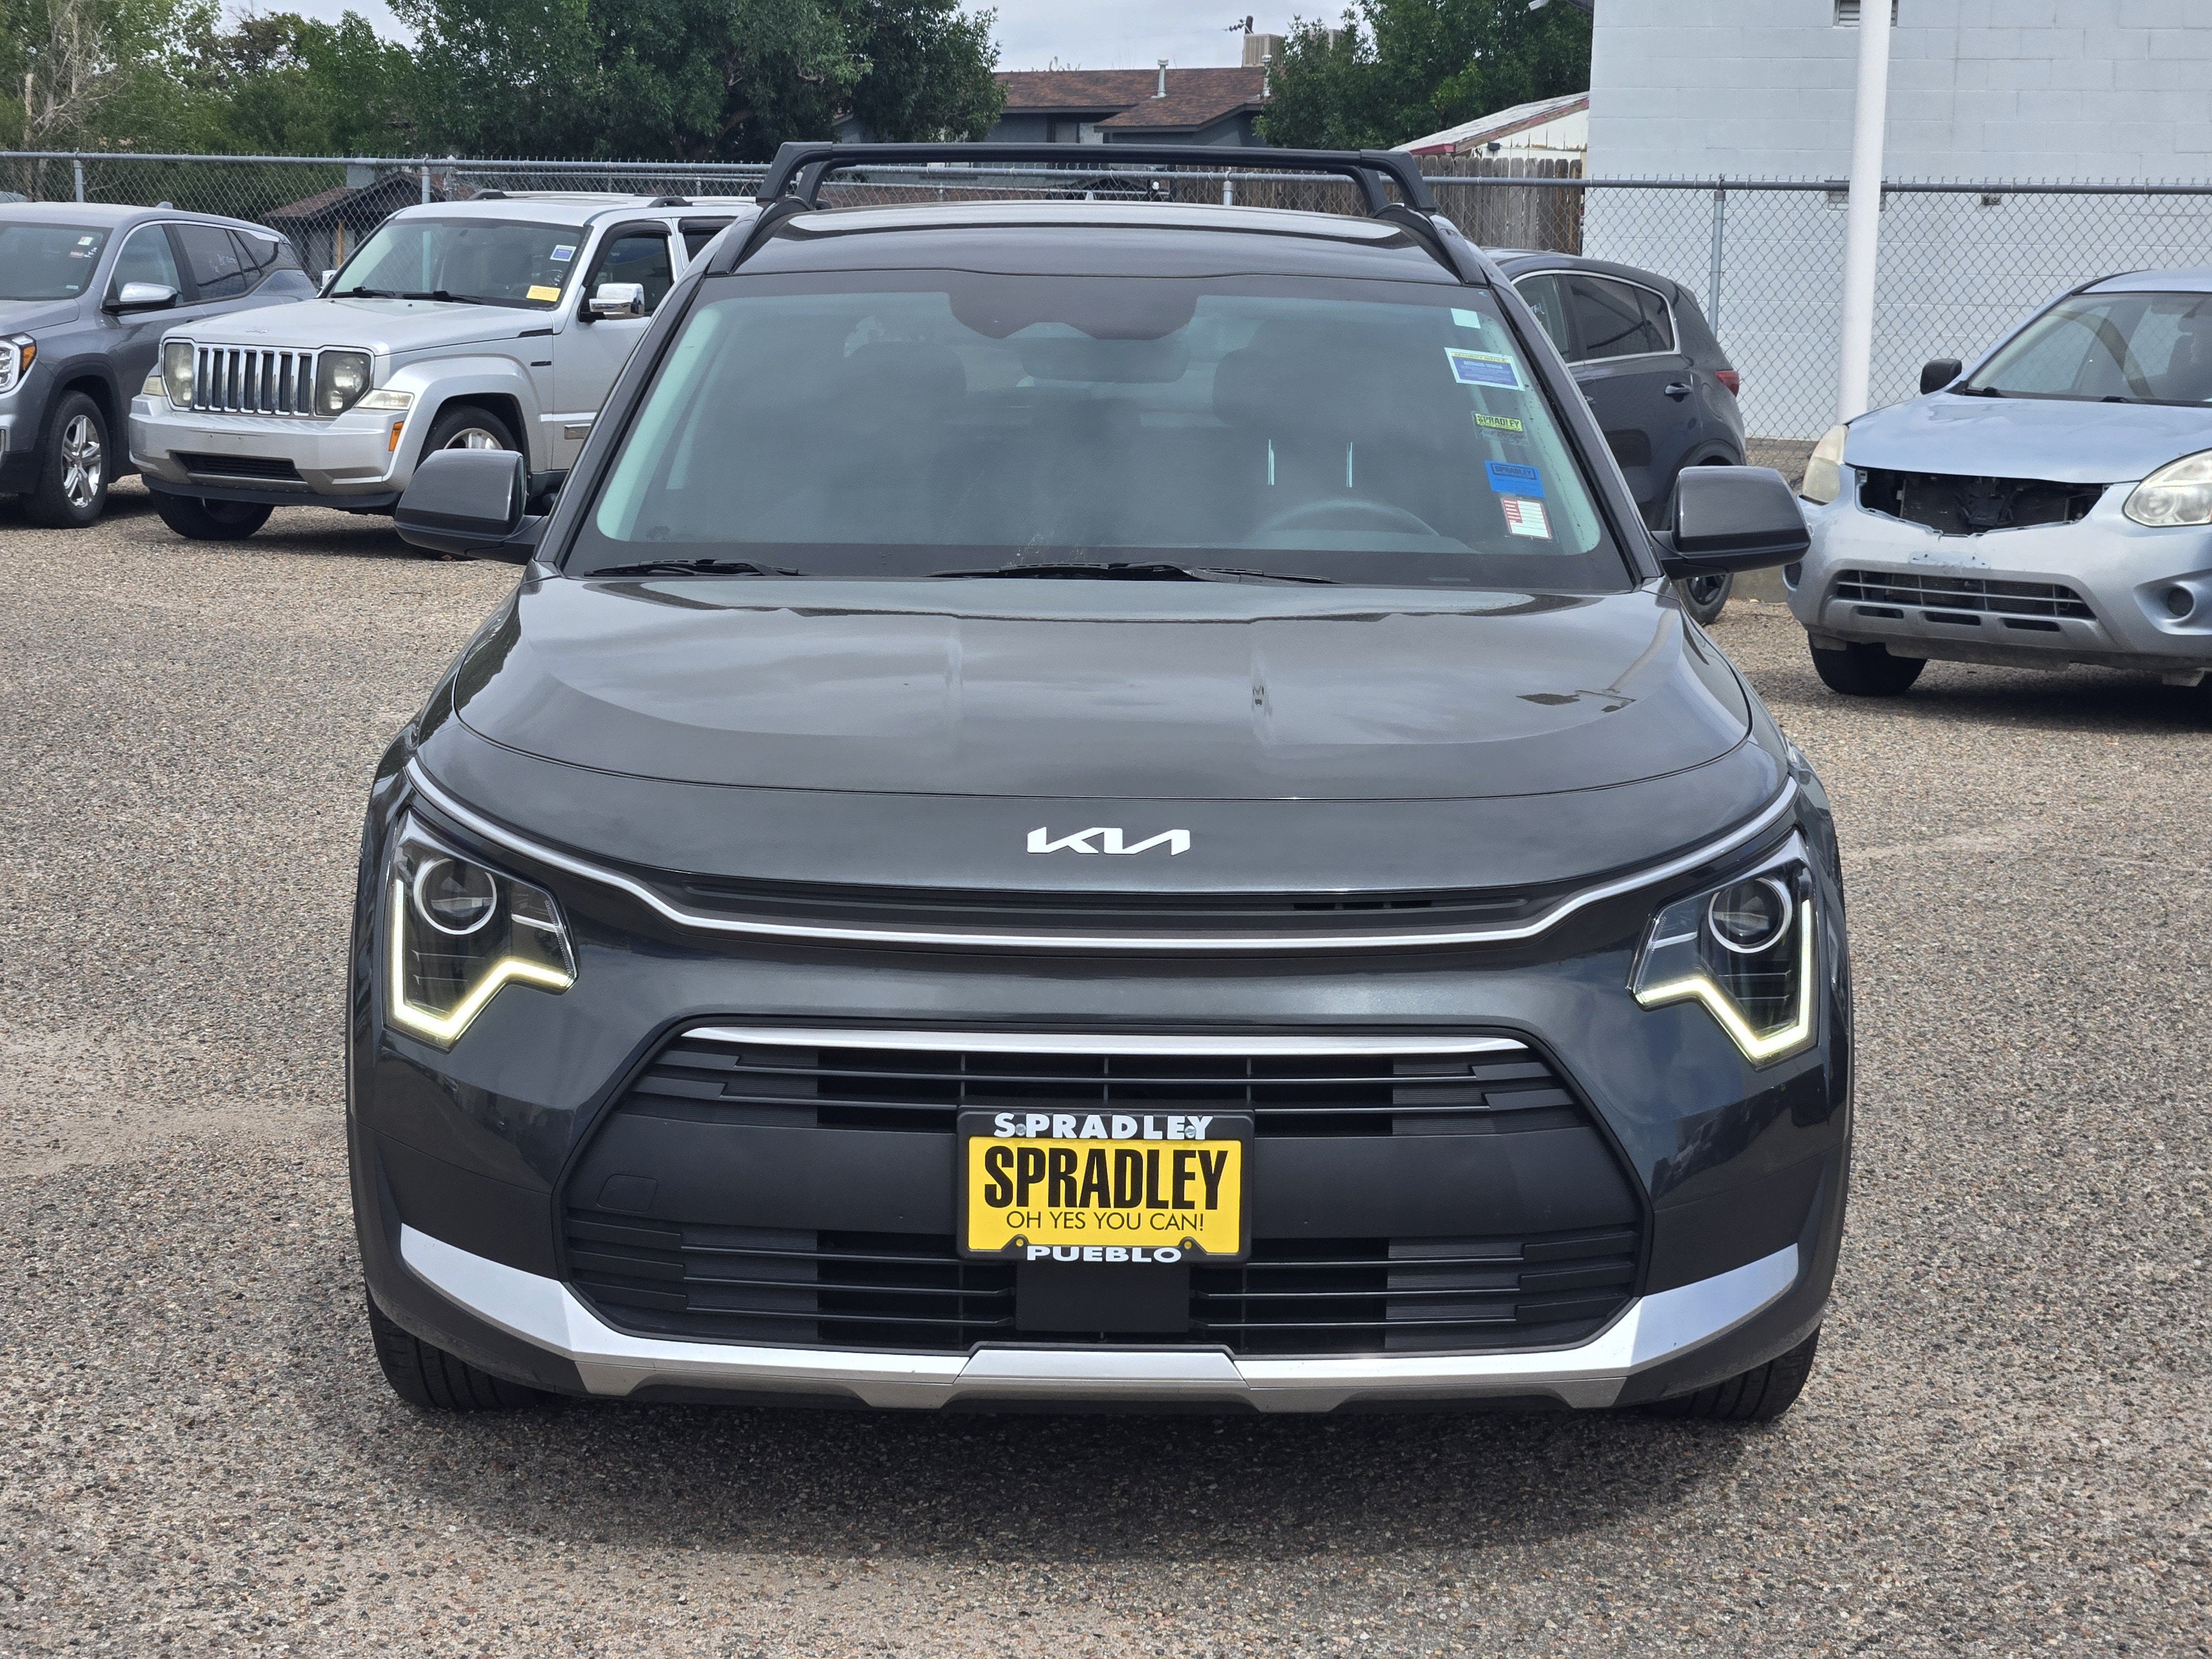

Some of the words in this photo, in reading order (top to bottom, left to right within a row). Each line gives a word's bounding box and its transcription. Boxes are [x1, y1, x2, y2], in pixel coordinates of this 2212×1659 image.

[1477, 415, 1520, 428] SPRADLEY
[1494, 466, 1532, 476] SPRADLEY
[994, 1113, 1213, 1140] SPRADLEY
[984, 1145, 1229, 1210] SPRADLEY
[1006, 1211, 1041, 1229] OH
[1049, 1211, 1086, 1230] YES
[1093, 1212, 1141, 1230] YOU
[1150, 1212, 1204, 1232] CAN!
[1027, 1246, 1182, 1264] PUEBLO
